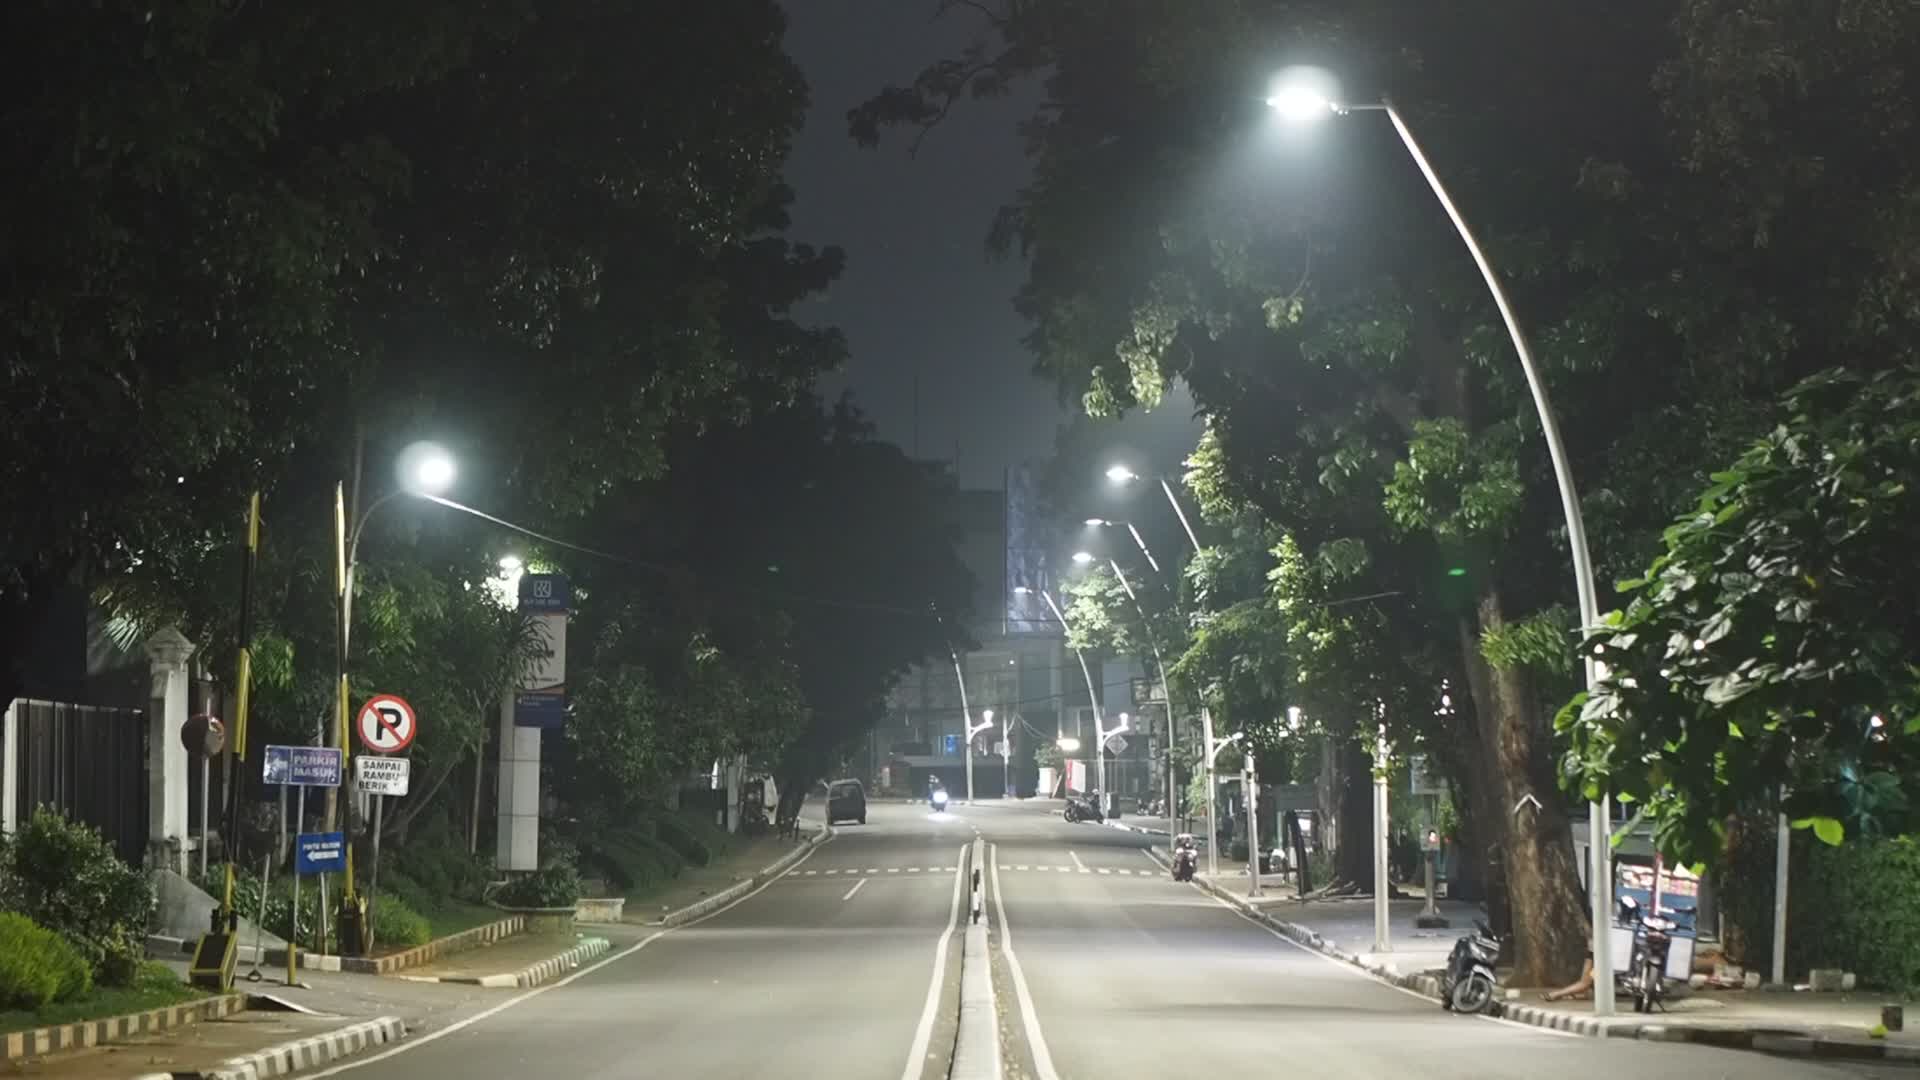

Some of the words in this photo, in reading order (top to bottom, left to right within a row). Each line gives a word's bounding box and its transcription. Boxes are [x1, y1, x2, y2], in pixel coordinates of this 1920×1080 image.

[376, 708, 402, 740] P
[294, 755, 337, 766] PARKIR
[362, 761, 401, 771] SAMPAI
[294, 767, 337, 777] MASUK
[363, 771, 400, 781] RAMBU
[358, 780, 400, 791] BERIK
